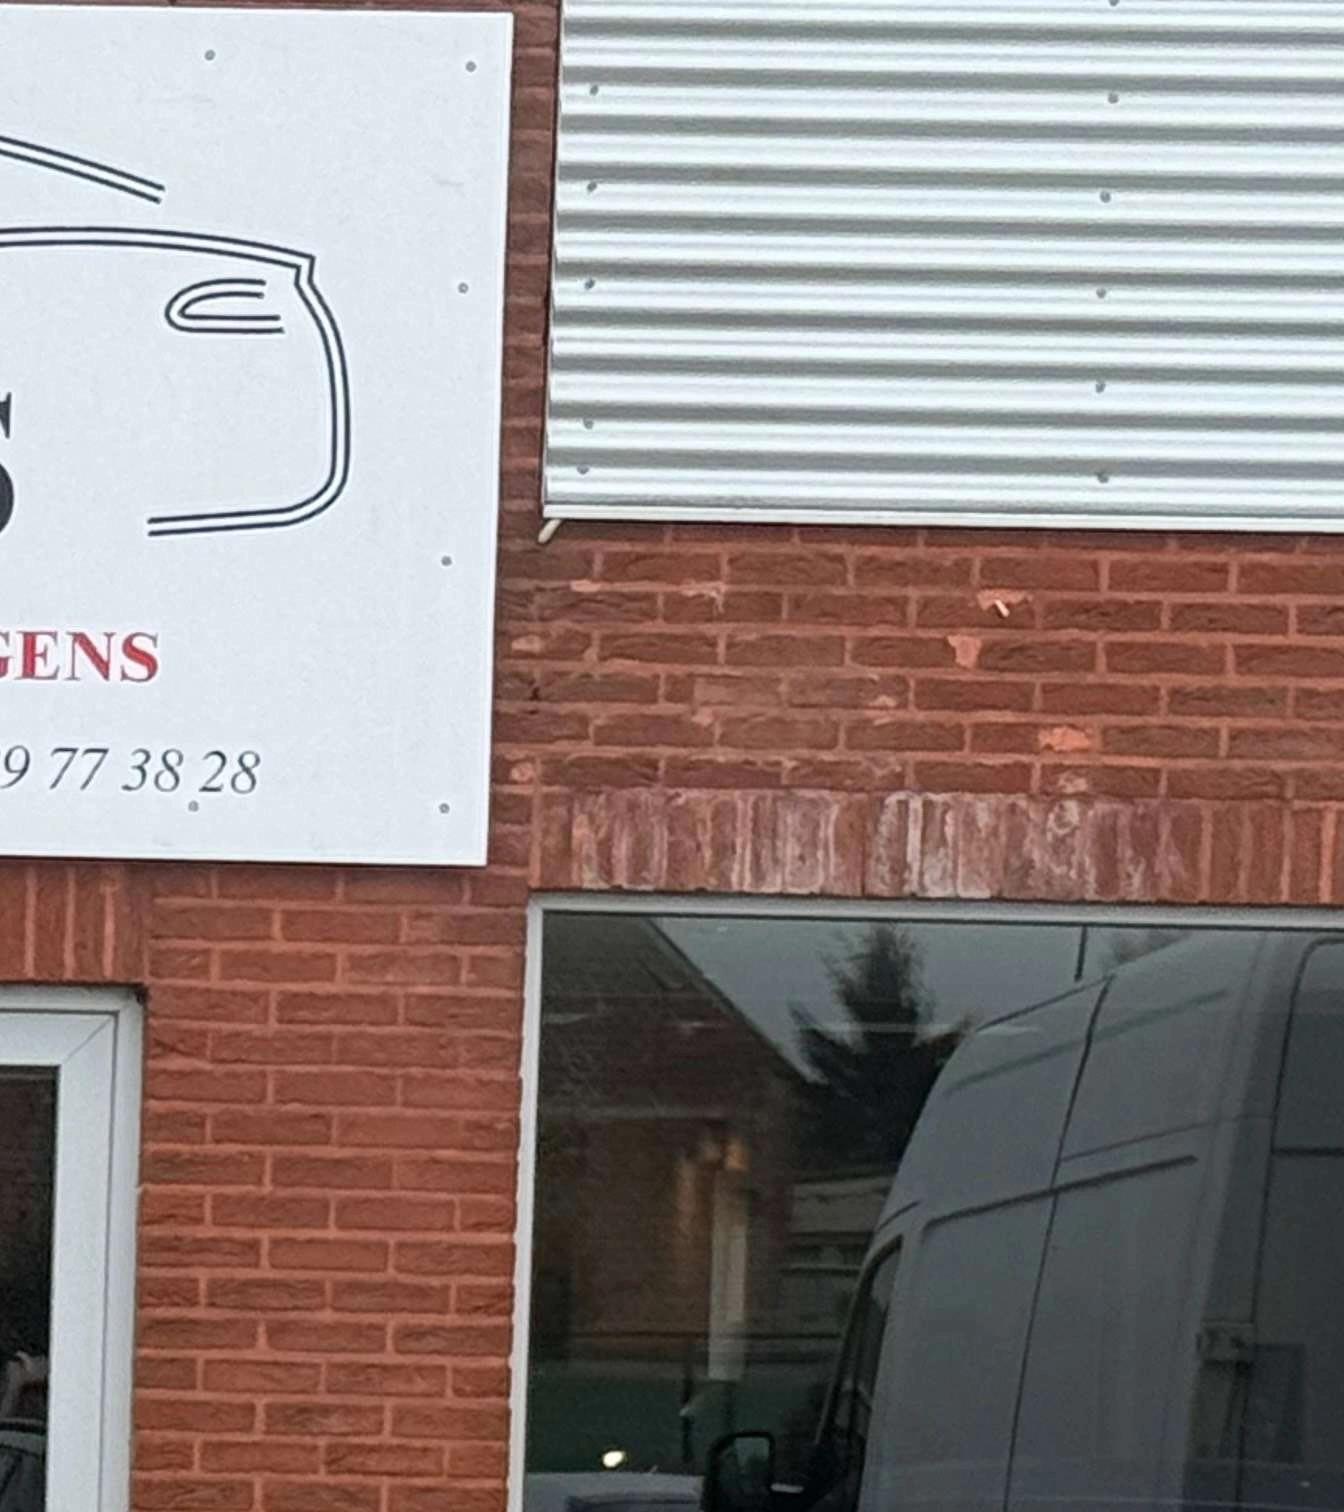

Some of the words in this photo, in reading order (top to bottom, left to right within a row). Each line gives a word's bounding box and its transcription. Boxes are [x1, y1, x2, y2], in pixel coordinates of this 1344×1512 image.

[48, 747, 110, 791] 77
[121, 748, 184, 793] 38
[198, 750, 261, 795] 28
